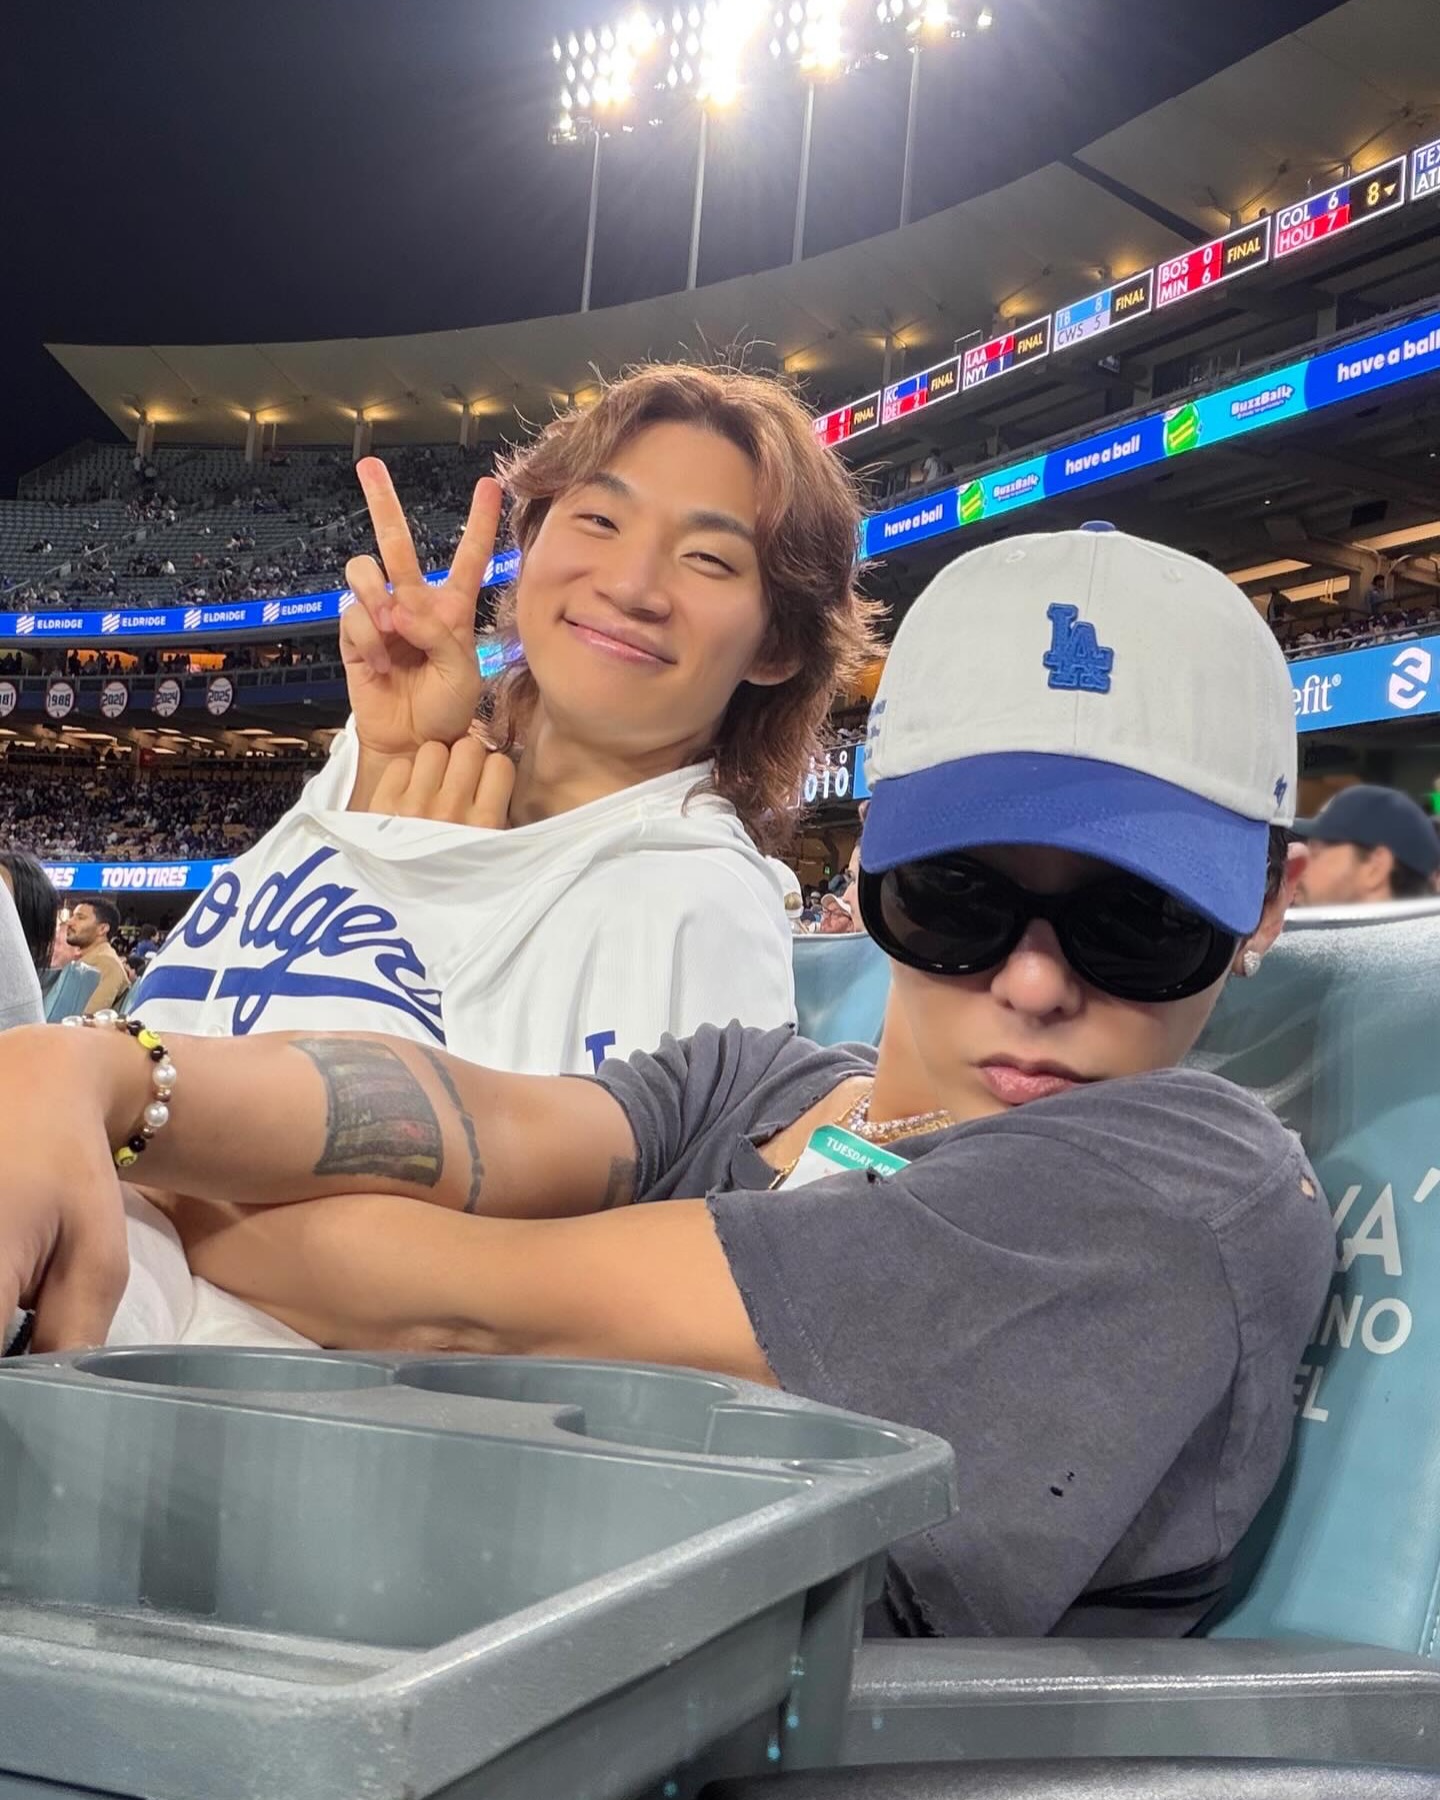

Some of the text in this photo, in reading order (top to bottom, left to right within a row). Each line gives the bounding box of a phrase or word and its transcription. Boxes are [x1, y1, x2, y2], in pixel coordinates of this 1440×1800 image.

[1367, 181, 1380, 206] 8
[1281, 191, 1339, 230] COL 6
[1280, 210, 1339, 252] HOU 7
[1227, 237, 1261, 264] FINAL
[1161, 247, 1213, 284] BOS 0
[1160, 267, 1211, 303] MIN 6
[1057, 296, 1103, 327] TB 8
[1115, 287, 1145, 312] FINAL
[1057, 315, 1102, 346] CWS 5
[967, 338, 1008, 369] LAA 7
[1017, 332, 1044, 355] FINAL
[966, 363, 989, 385] NYY
[1337, 356, 1385, 383] have
[1387, 348, 1400, 366] a
[931, 371, 954, 392] FINAL
[885, 394, 920, 419] DET 2
[886, 386, 899, 404] KC
[839, 409, 846, 424] 4
[853, 406, 875, 425] FINAL
[1065, 434, 1141, 476] have a ball
[884, 521, 912, 538] have
[912, 517, 920, 528] a
[921, 504, 944, 523] ball
[121, 615, 167, 627] ELDRIDGE
[203, 610, 246, 624] ELDRIDGE
[281, 601, 322, 616] ELDRIDGE
[37, 618, 84, 630] ELDRIDGE
[1043, 602, 1114, 695] LA
[48, 693, 71, 708] 1988
[102, 693, 125, 706] 2020
[156, 690, 178, 703] 2024
[208, 689, 231, 702] 2025
[822, 769, 830, 799] 1
[101, 867, 146, 887] TOYO
[146, 865, 189, 887] TIRES
[827, 1136, 874, 1170] TUESDAY
[1310, 1294, 1413, 1355] NO
